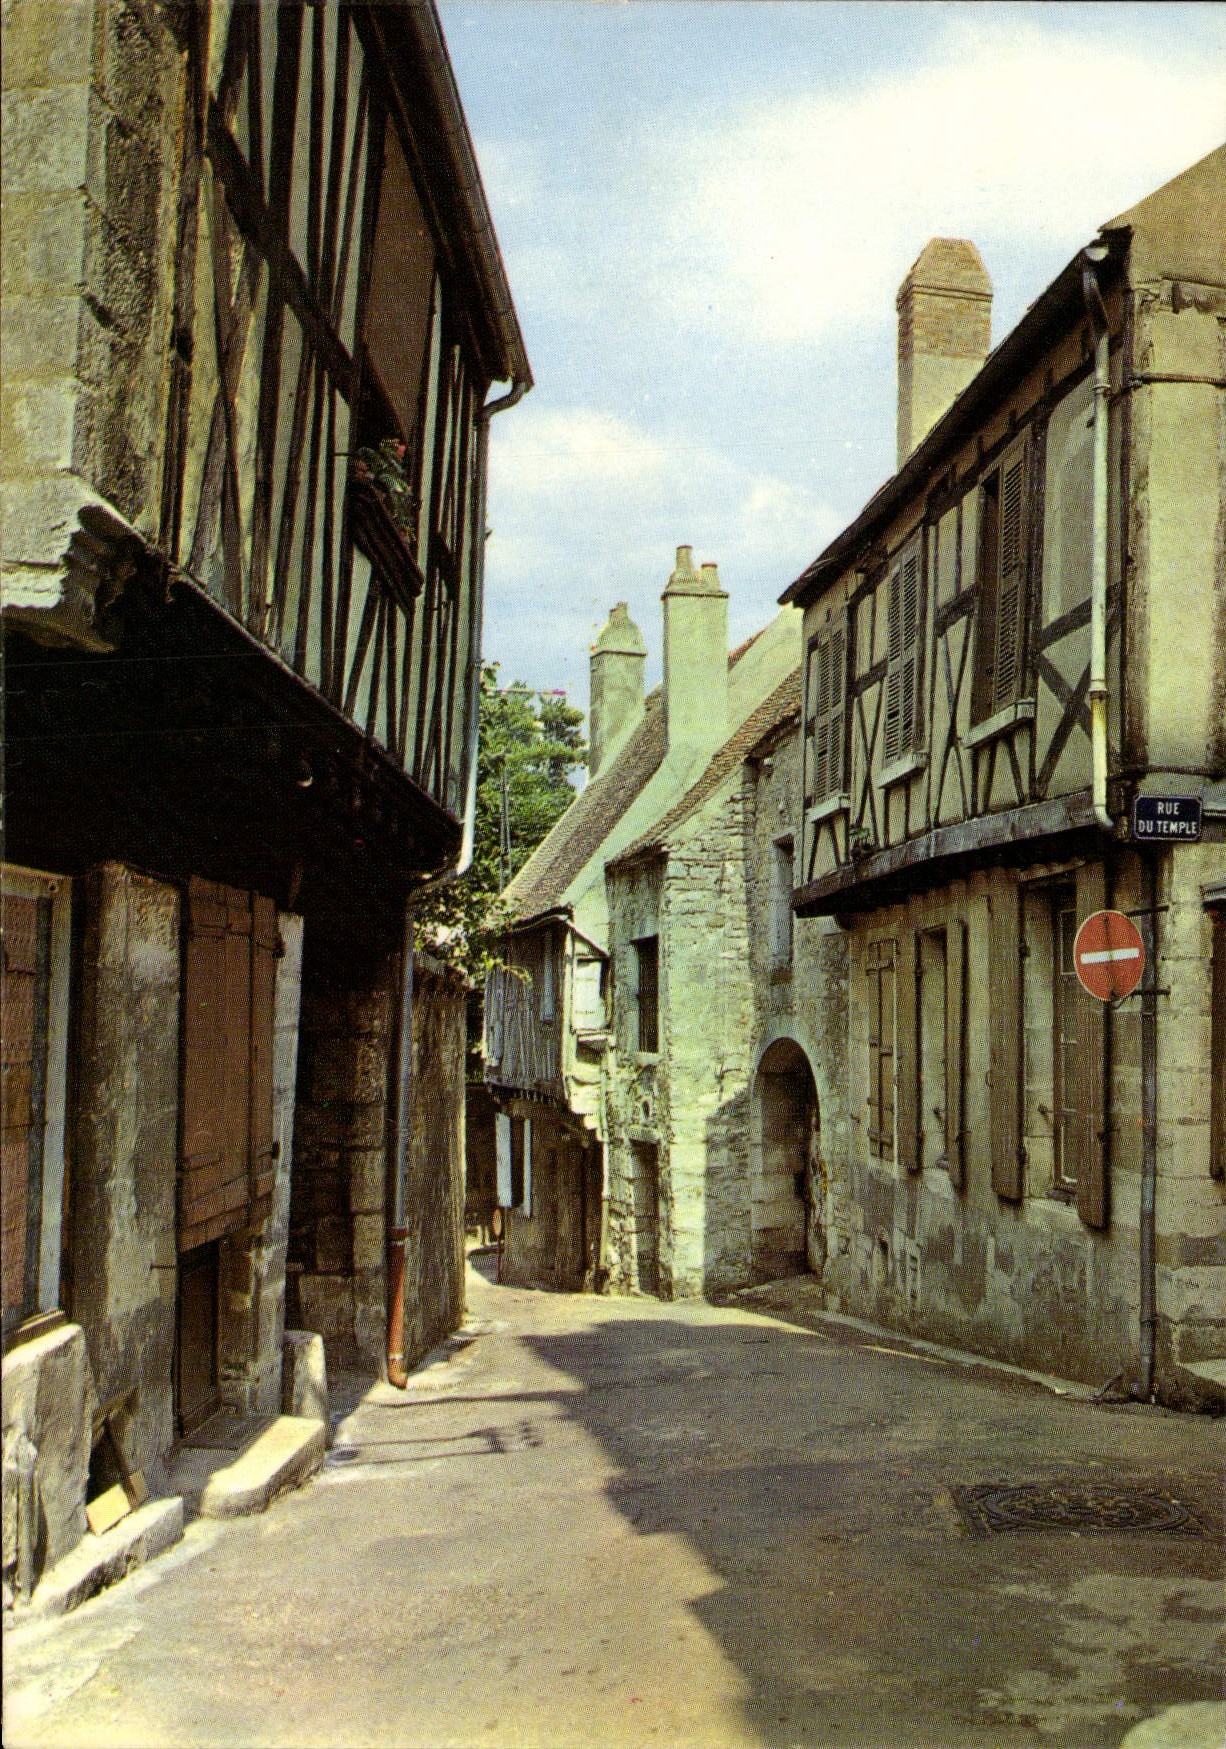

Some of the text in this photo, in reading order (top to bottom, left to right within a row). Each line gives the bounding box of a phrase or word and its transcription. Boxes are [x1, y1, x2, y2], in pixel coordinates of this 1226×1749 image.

[1157, 802, 1180, 815] RUE
[1138, 820, 1197, 834] DU TEMPLE
